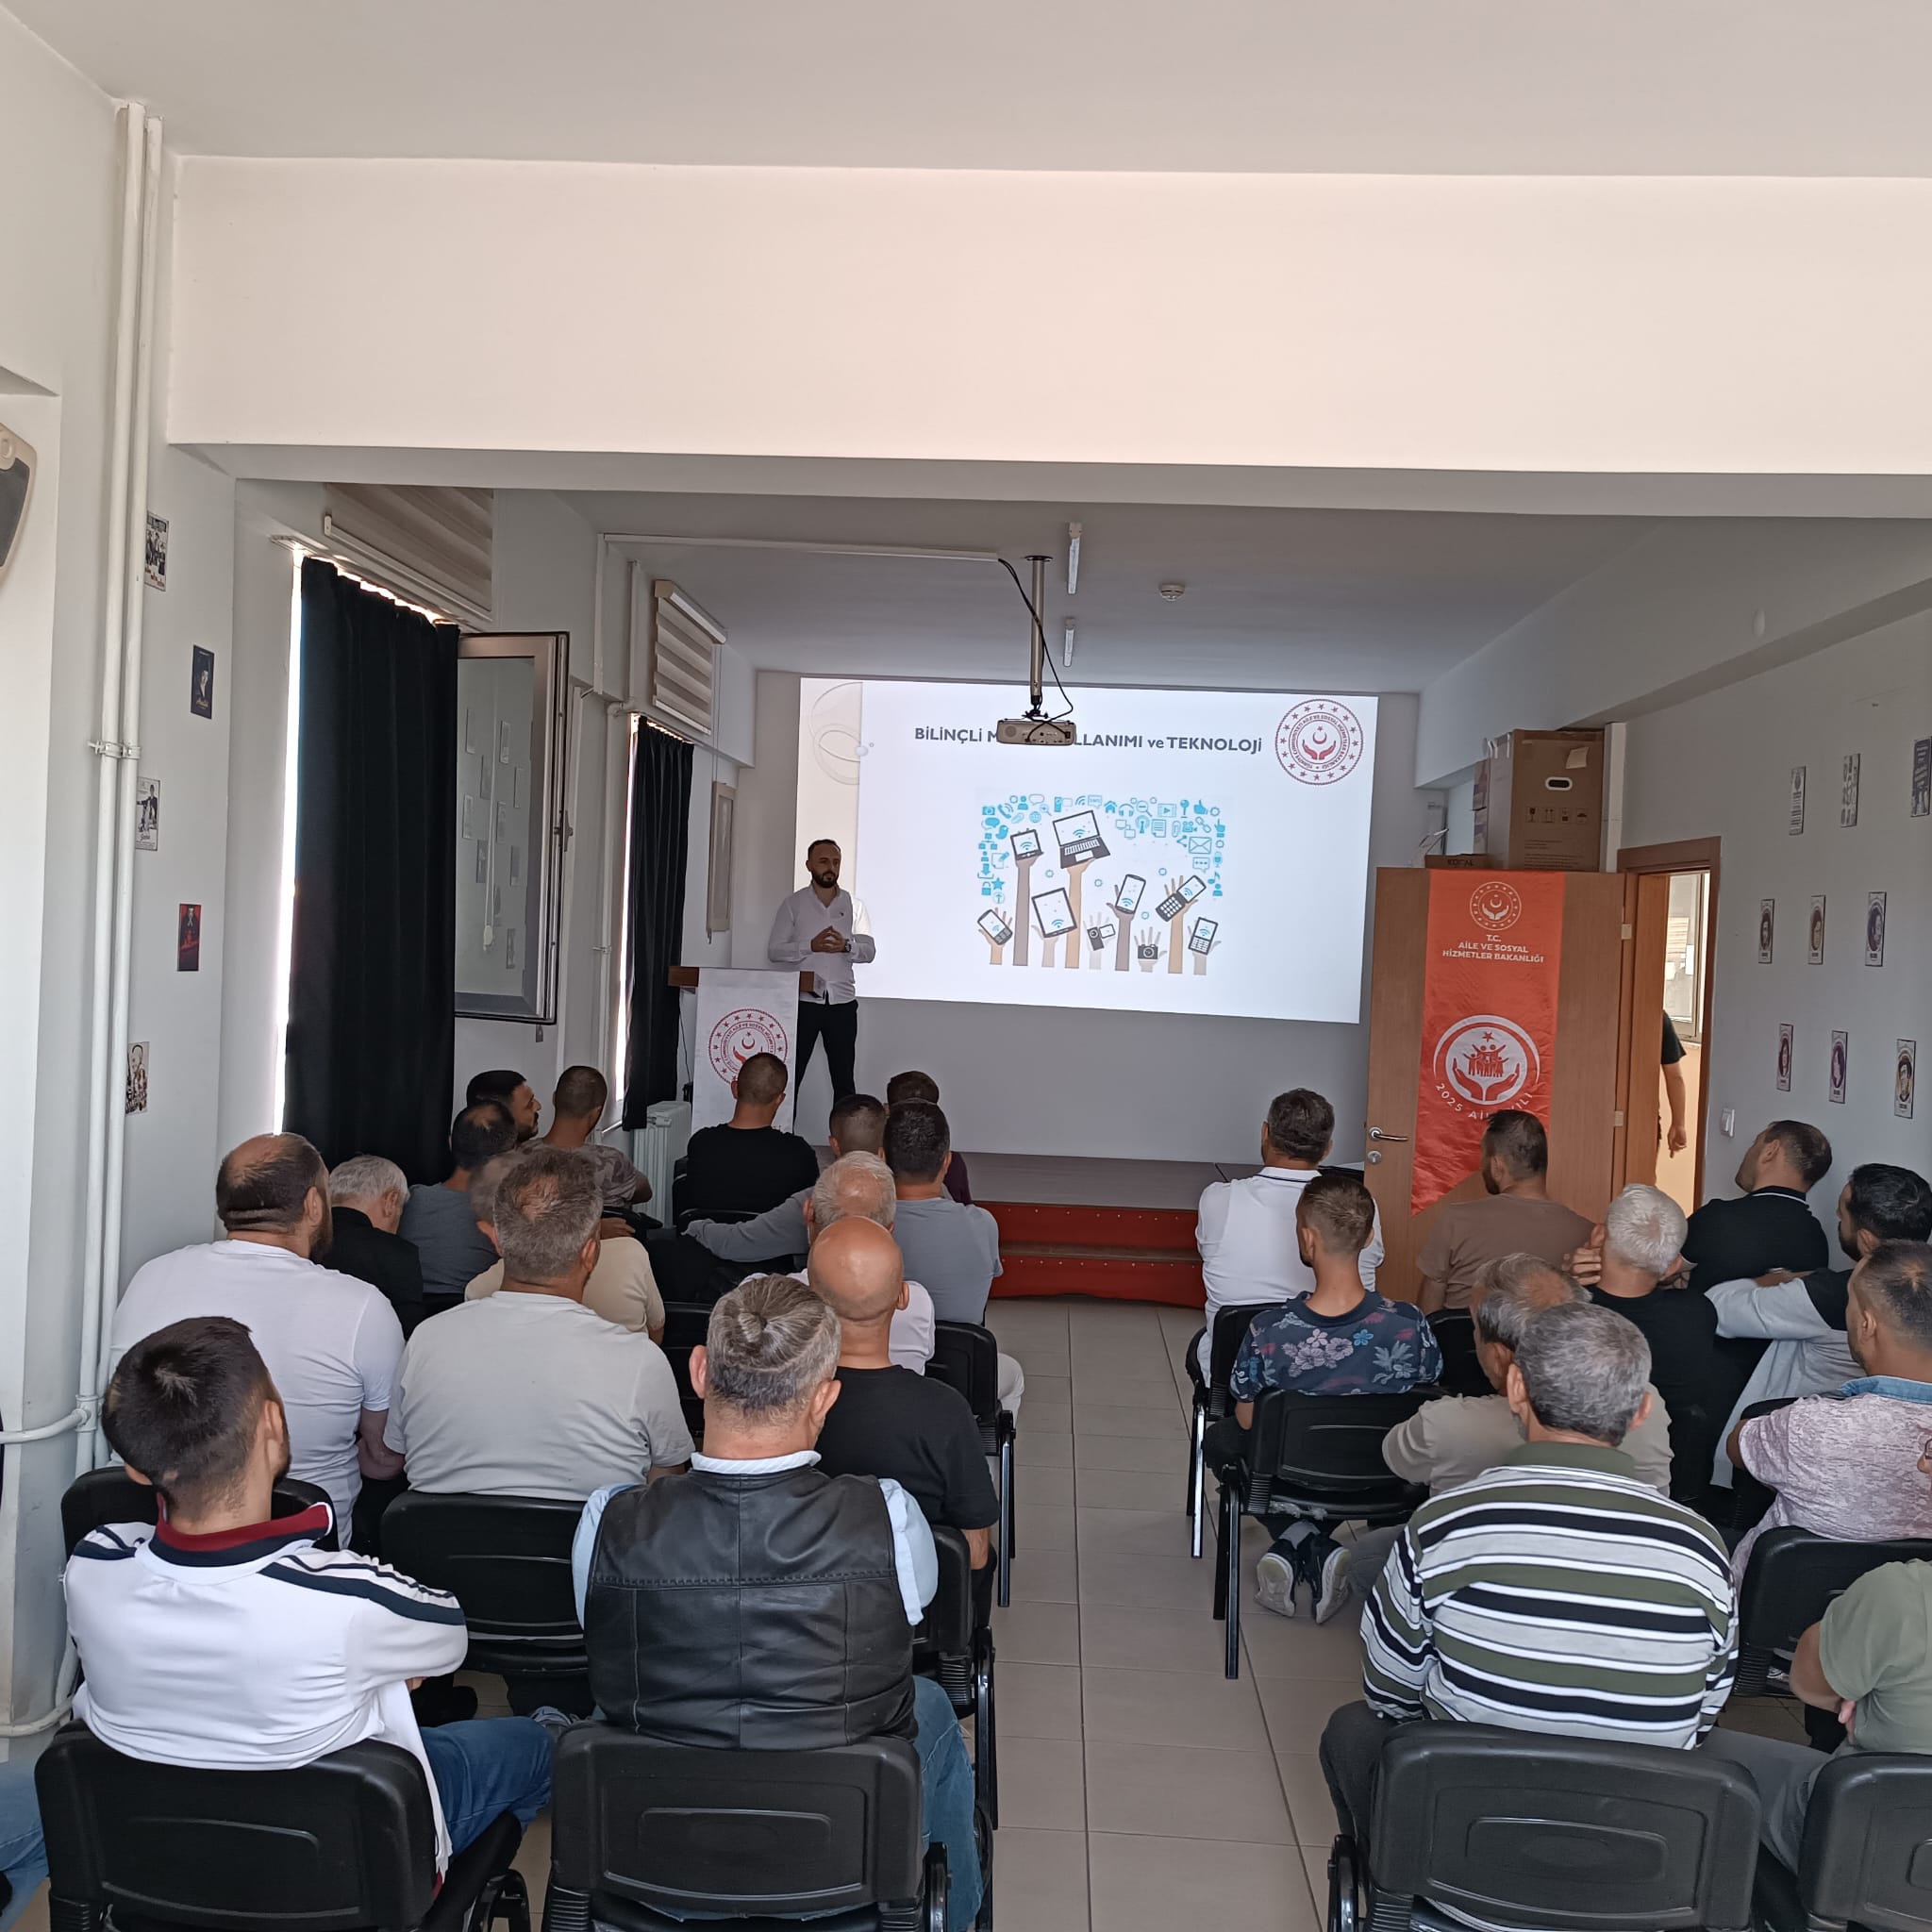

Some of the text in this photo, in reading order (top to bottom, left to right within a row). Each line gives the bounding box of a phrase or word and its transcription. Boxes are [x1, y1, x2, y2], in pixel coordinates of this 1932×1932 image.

[914, 725, 983, 744] BİLİNÇLİ
[1147, 739, 1165, 749] ve
[1166, 736, 1263, 755] TEKNOLOJİ
[1442, 948, 1544, 963] HİZMETLER BAKANLIĞI
[1457, 941, 1479, 950] AİLE
[1494, 944, 1529, 953] SOSYAL
[1435, 1082, 1463, 1112] 2025
